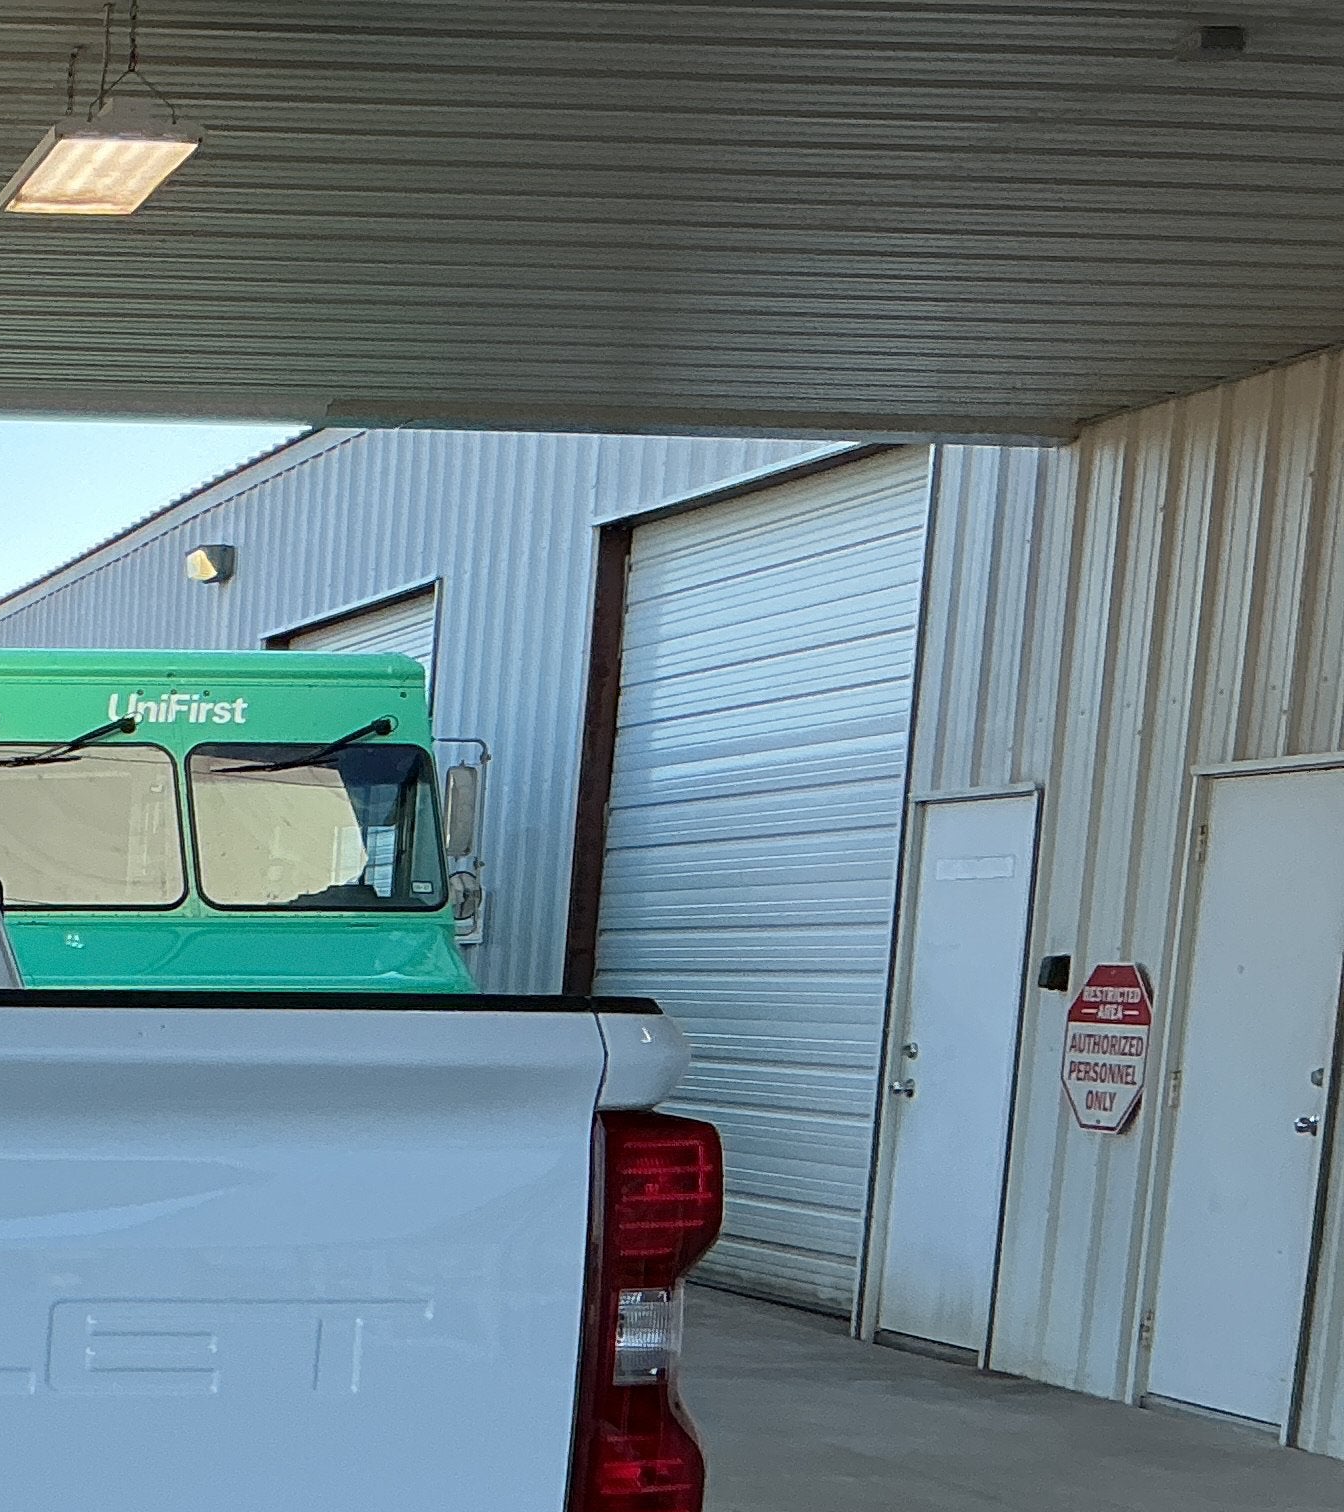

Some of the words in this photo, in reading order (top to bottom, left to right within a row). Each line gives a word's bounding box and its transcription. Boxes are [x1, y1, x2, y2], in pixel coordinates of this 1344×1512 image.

[108, 693, 248, 724] UniFirst
[1083, 986, 1142, 1003] RESTRICTED
[1097, 1004, 1123, 1020] AREA
[1069, 1032, 1144, 1057] AUTHORIZED
[1068, 1060, 1137, 1086] PERSONNEL
[1085, 1089, 1117, 1112] ONLY
